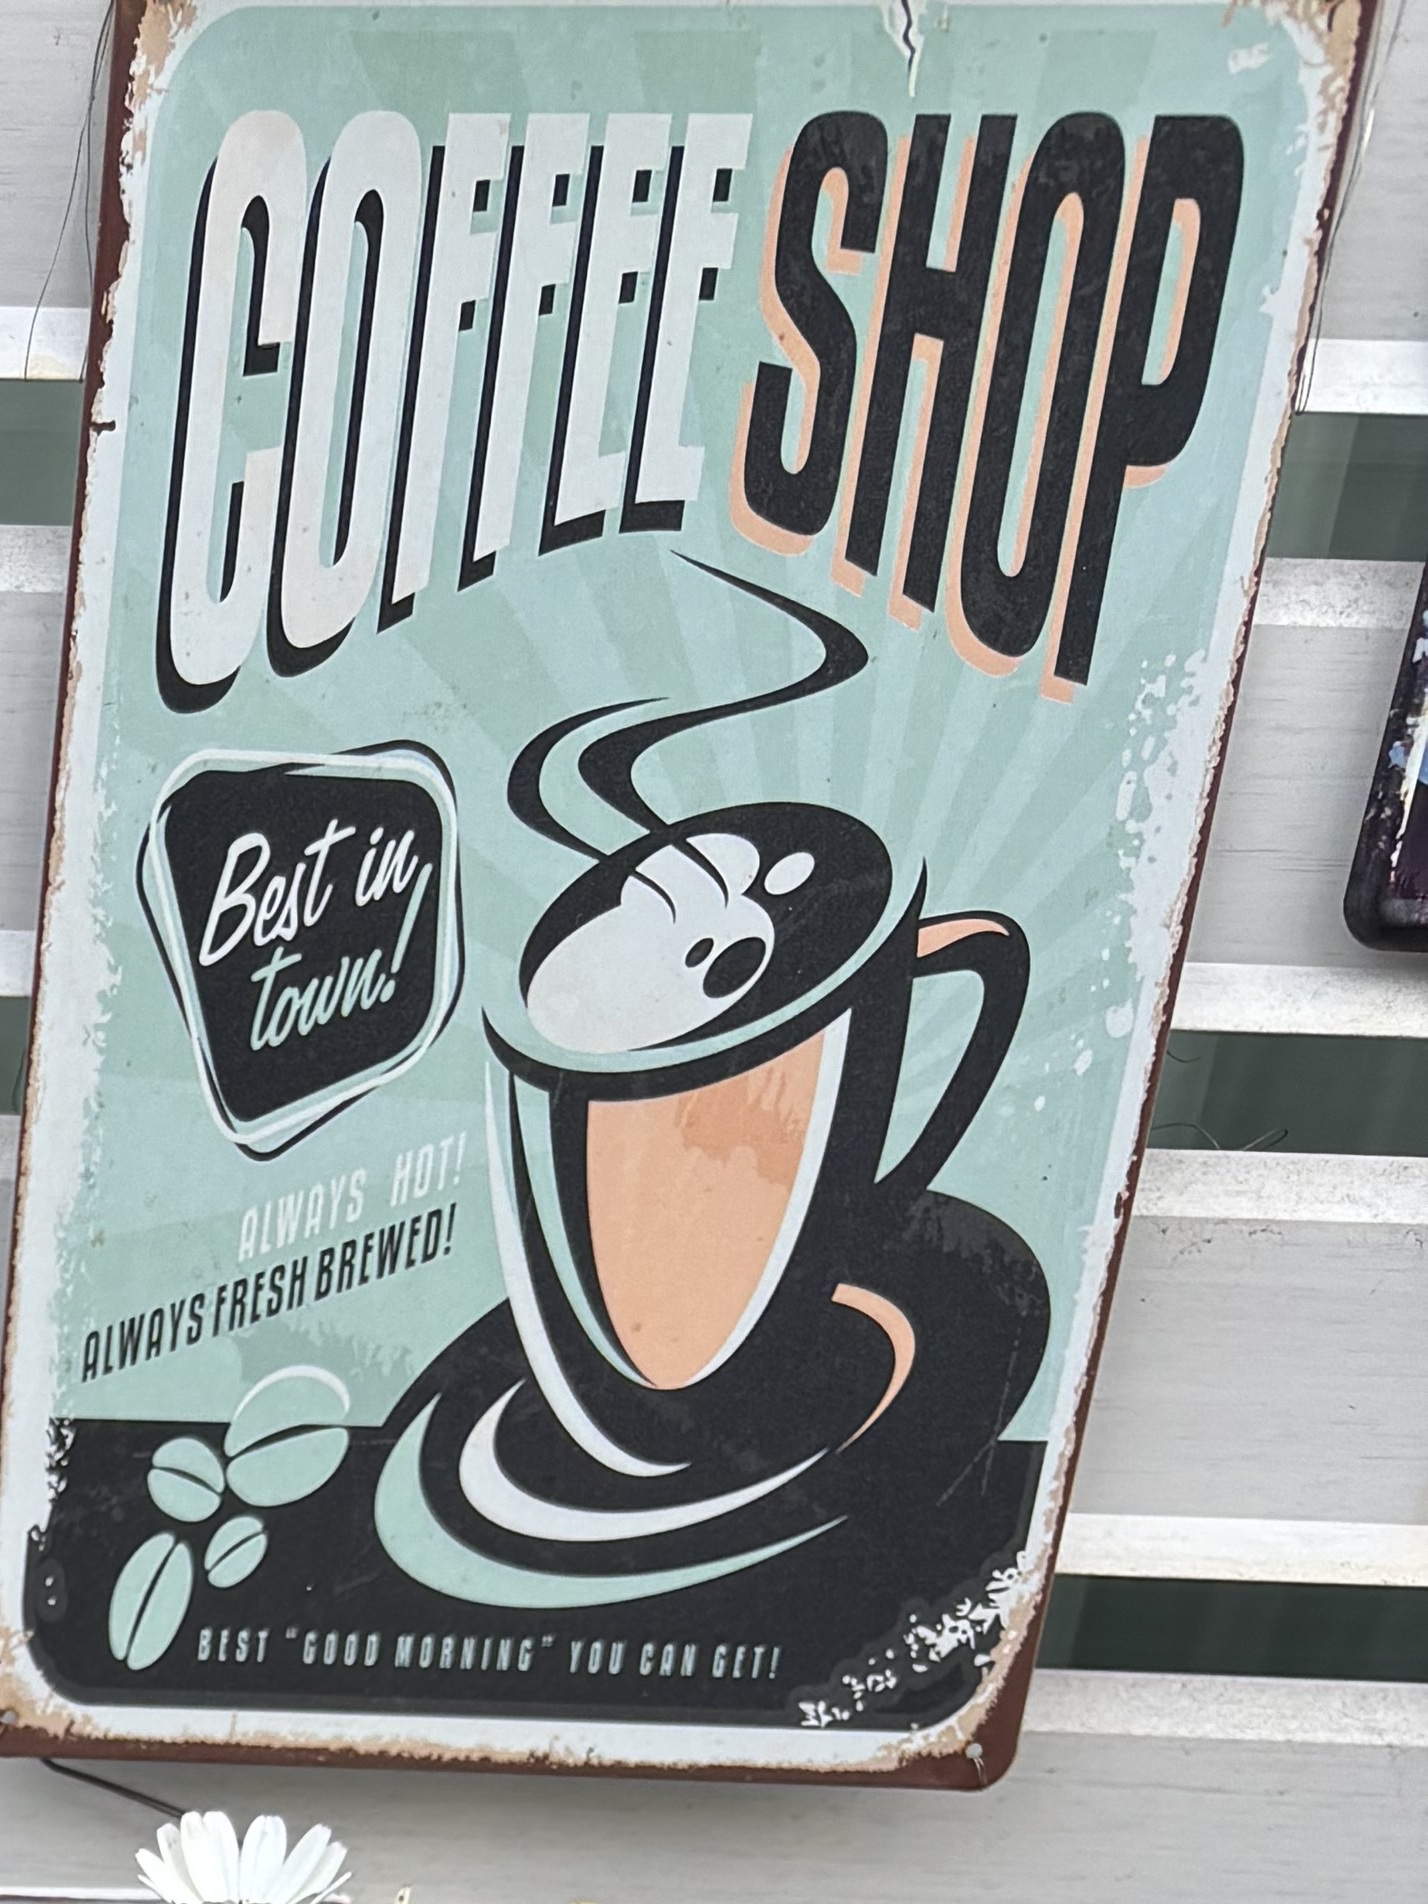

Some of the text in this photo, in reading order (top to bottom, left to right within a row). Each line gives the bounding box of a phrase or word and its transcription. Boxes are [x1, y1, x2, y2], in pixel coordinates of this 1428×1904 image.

[156, 108, 1245, 713] COFFEE SHOP
[198, 818, 419, 967] Best in
[250, 862, 434, 1051] town!
[238, 1131, 467, 1263] ALWAYS HOT!
[81, 1202, 457, 1383] ALWAYS FRESH BREWED!
[197, 1626, 270, 1663] BEST
[568, 1640, 627, 1676] YOU
[638, 1640, 697, 1678] CAN
[711, 1643, 783, 1681] GET!
